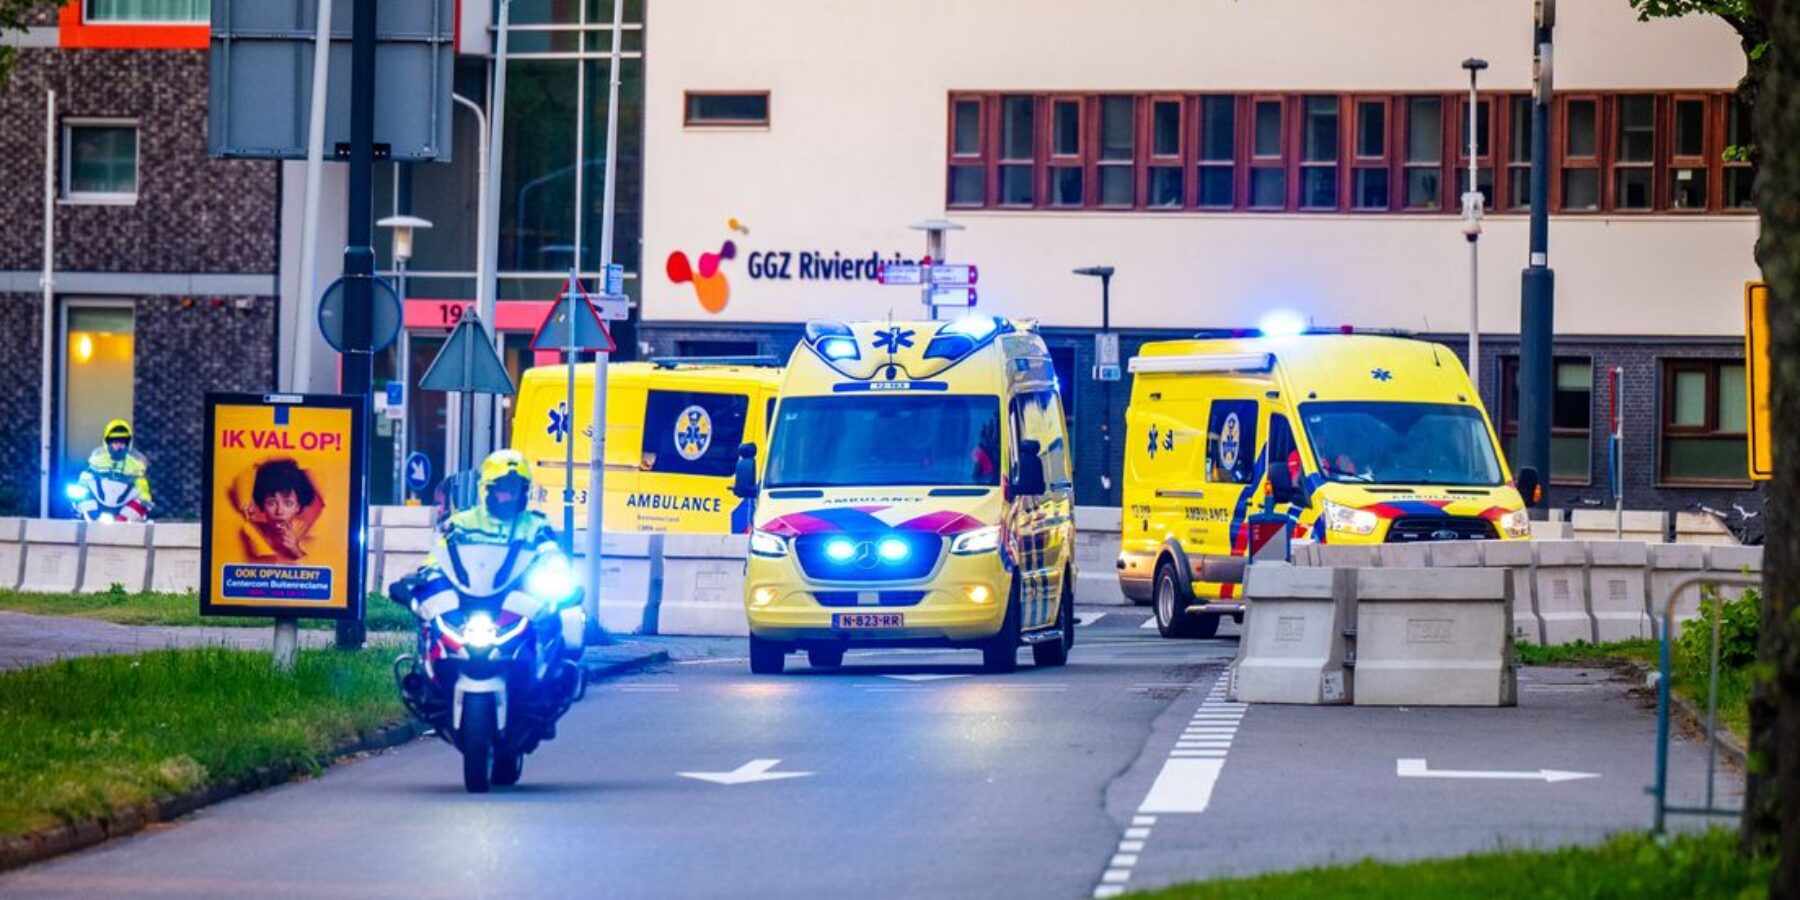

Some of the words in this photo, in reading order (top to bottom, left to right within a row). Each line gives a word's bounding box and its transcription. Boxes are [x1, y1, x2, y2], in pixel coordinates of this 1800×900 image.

[748, 251, 791, 280] GGZ
[440, 304, 462, 324] 19
[222, 429, 246, 449] IK
[250, 430, 296, 450] VAL
[300, 431, 342, 452] OP!
[626, 493, 721, 513] AMBULANCE
[235, 568, 257, 579] OOK
[259, 568, 321, 580] OPVALLEN?
[843, 614, 900, 627] N-823-RR
